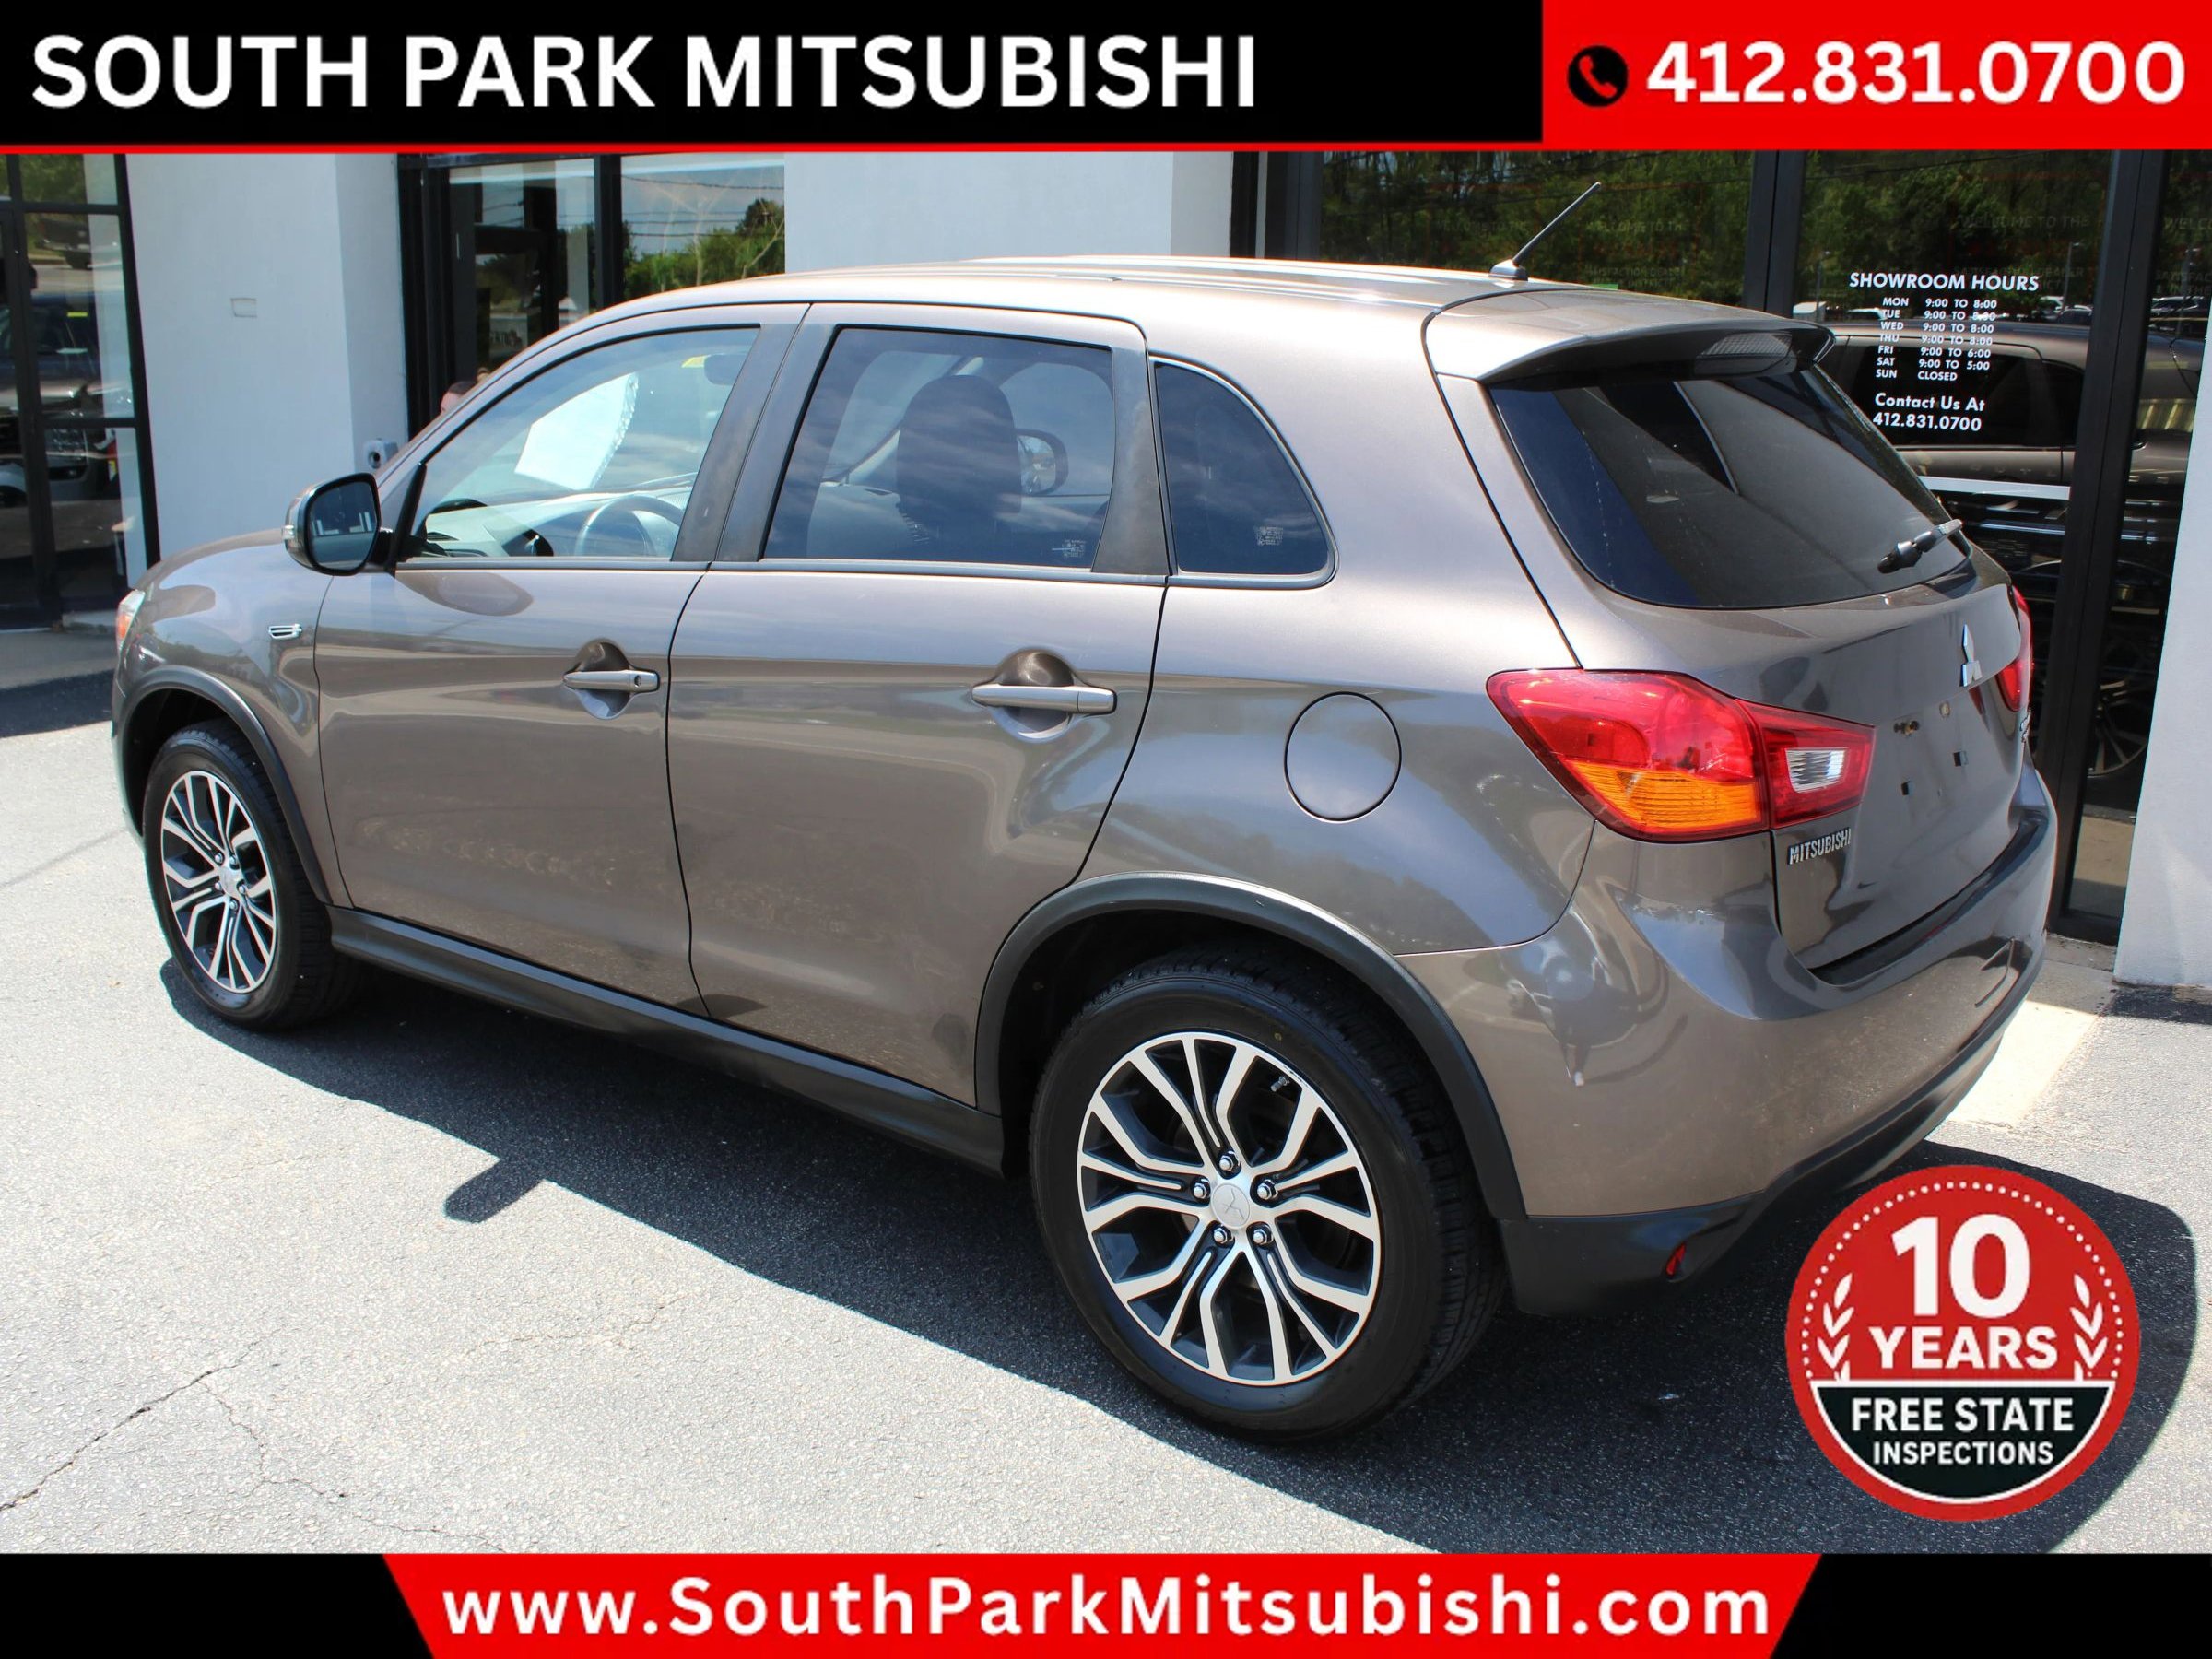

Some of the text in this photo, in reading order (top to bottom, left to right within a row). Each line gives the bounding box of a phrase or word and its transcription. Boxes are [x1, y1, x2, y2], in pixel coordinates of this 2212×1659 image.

[1849, 273, 1965, 291] SHOWROOM
[1971, 275, 2039, 291] HOURS
[1882, 297, 1997, 309] MON 9:00 TO 8:00
[1882, 309, 1900, 319] TUE
[1924, 310, 1946, 320] 9:00
[1952, 311, 1965, 321] TO
[1881, 321, 1994, 334] WED 9:00 TO 8:00
[1880, 334, 1993, 347] THU 9:00 TO 8:00
[1878, 346, 1991, 359] FRI 9:00 TO 6:00
[1877, 357, 1990, 371] SAT 9:00 TO 5:00
[1876, 369, 1958, 382] SUN CLOSED
[1875, 392, 1985, 411] Contact Us At
[1873, 412, 1982, 431] 412.831.0700
[1788, 827, 1852, 865] MITSUBISHI
